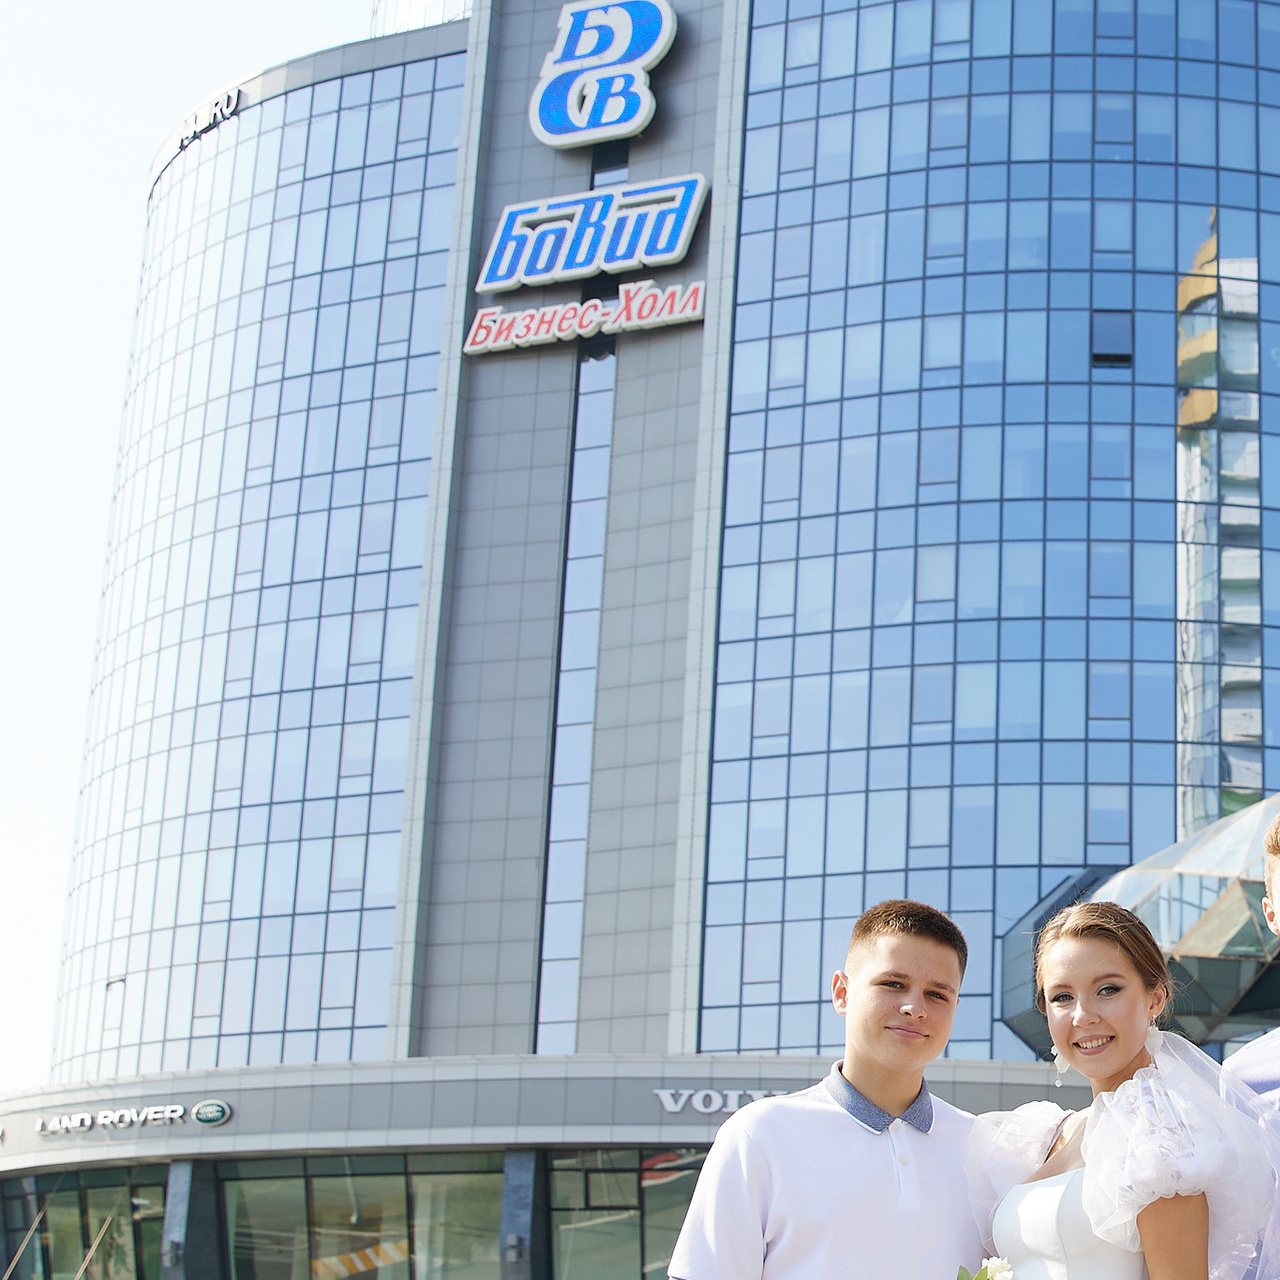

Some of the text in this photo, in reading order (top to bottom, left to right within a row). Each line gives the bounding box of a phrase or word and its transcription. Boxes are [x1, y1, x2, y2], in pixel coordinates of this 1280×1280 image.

[467, 282, 703, 350] Бизнес-Холл
[35, 1112, 92, 1135] LAND
[97, 1104, 186, 1129] ROVER
